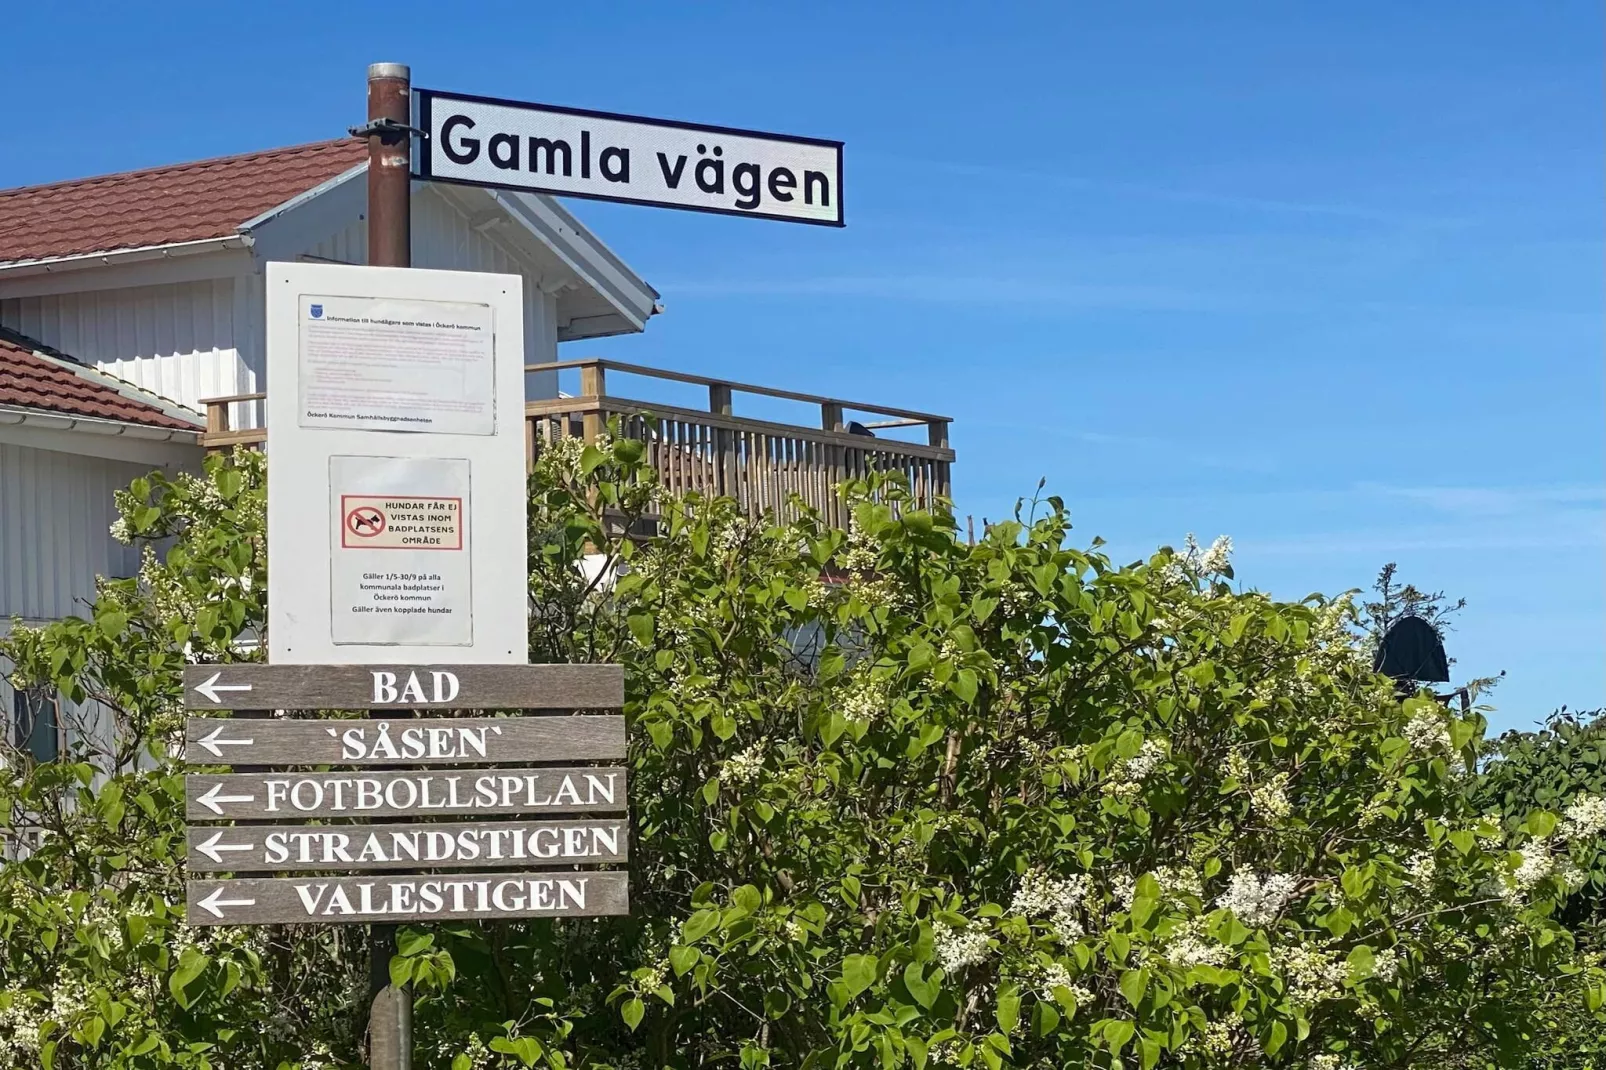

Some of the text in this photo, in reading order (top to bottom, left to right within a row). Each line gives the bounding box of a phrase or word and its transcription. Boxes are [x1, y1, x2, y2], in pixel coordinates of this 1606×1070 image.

[440, 114, 829, 209] Gamla vägen
[327, 315, 360, 323] Information
[356, 414, 432, 423] Samhällsbyggnadsenheten
[386, 502, 457, 511] HUNDAR FÅR EJ
[388, 526, 454, 534] BADPLATSENS
[402, 536, 441, 544] OMRÅDE
[418, 573, 428, 582] på
[403, 584, 440, 592] badplatser
[374, 592, 399, 600] Öckerö
[371, 671, 459, 703] BAD
[263, 773, 617, 812] FOTBOLLSPLAN
[263, 825, 620, 864] STRANDSTIGEN
[293, 877, 588, 915] VALESTIGEN
